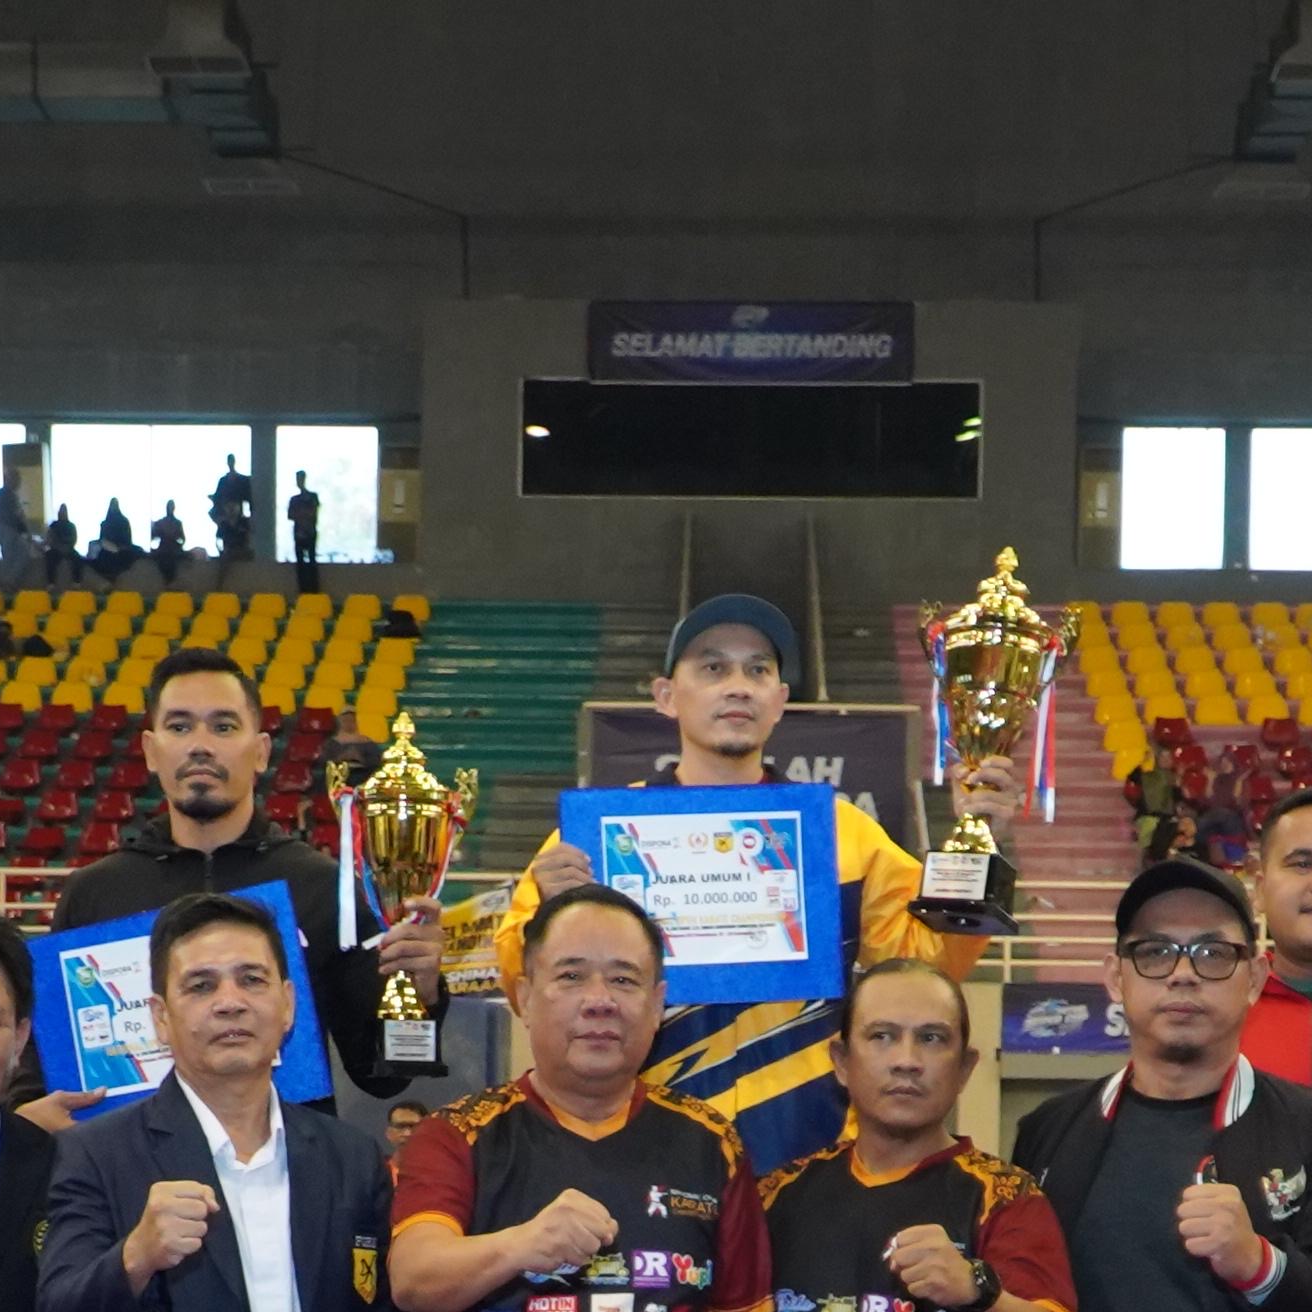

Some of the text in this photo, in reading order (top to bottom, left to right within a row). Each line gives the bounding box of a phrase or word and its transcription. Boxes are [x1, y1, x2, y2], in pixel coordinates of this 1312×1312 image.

[611, 333, 728, 358] SELAMAT
[652, 873, 696, 885] JUARA
[701, 873, 742, 883] UMUM
[683, 891, 759, 906] 10.000.000
